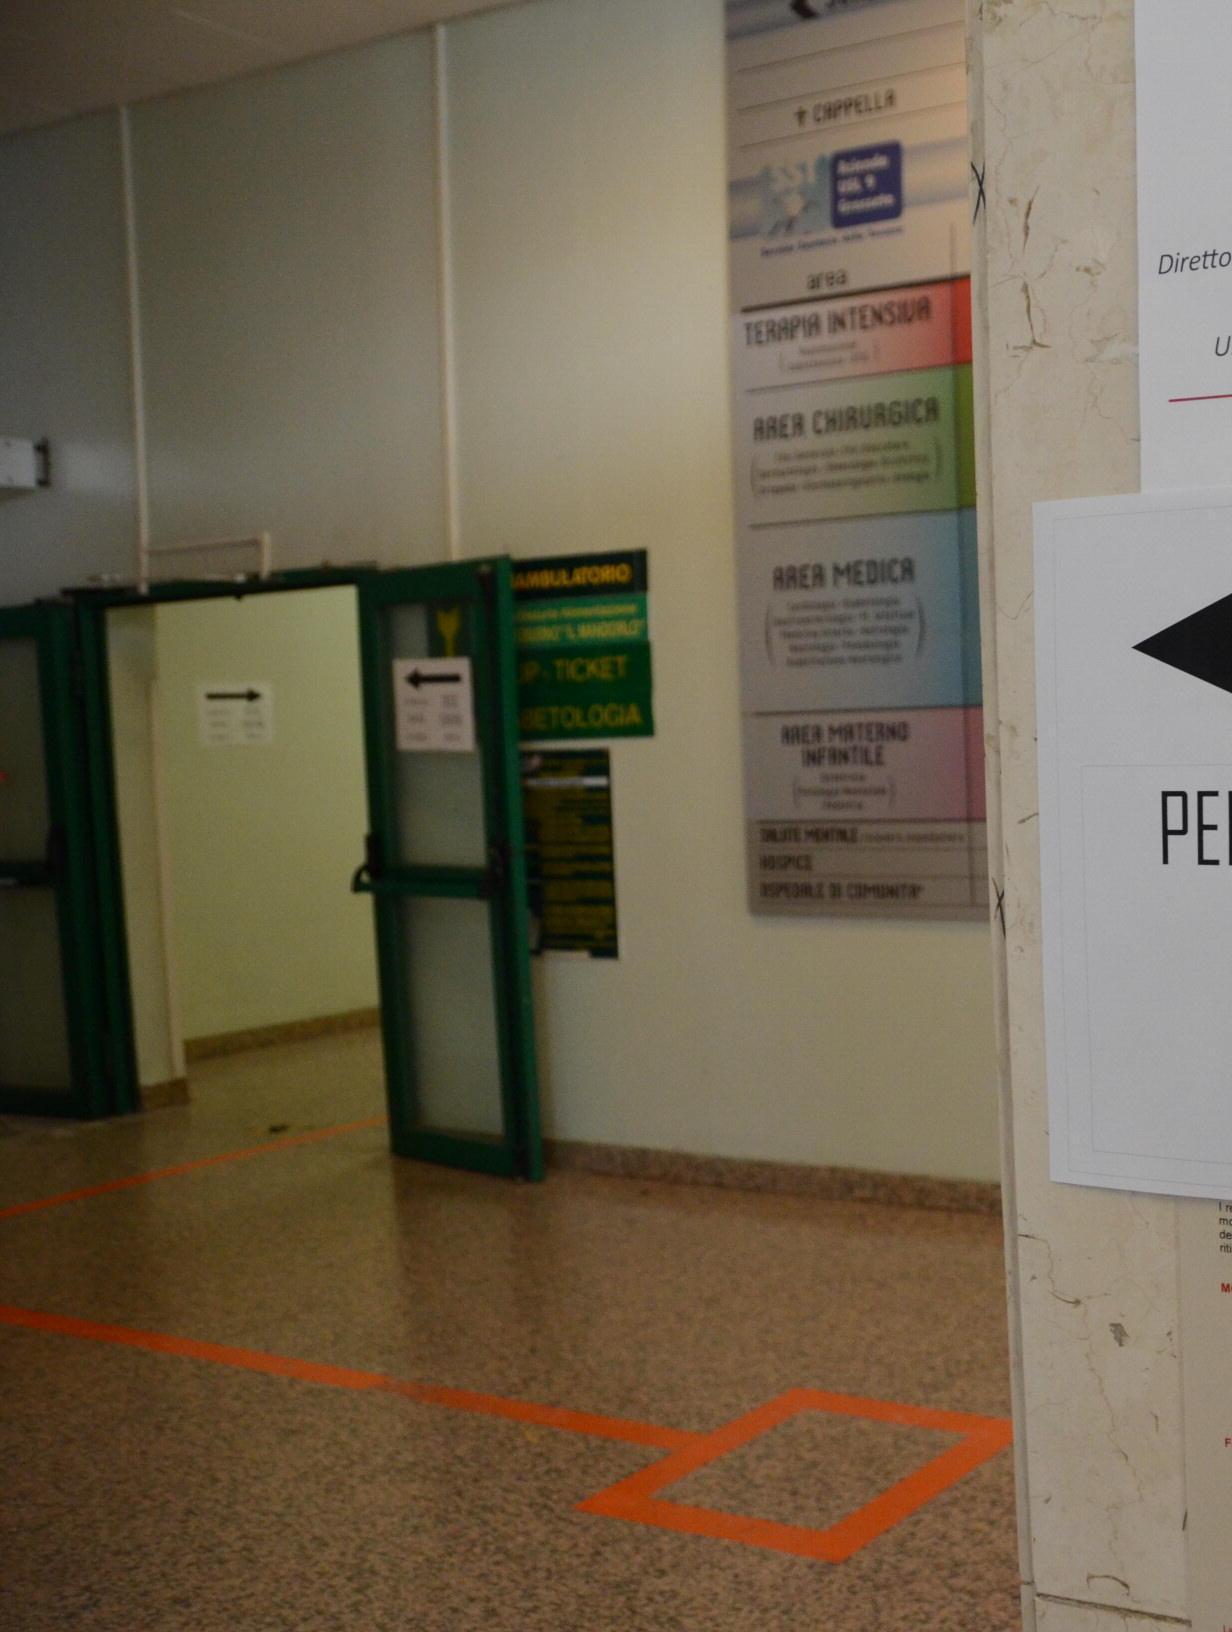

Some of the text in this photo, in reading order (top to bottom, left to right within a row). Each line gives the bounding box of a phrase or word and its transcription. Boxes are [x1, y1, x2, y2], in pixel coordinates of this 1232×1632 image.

[812, 88, 897, 123] CAPPELLA
[806, 269, 847, 290] area
[744, 296, 931, 346] TERAPIA INTENSIVA
[753, 397, 940, 440] AREA CHIRURGICA
[772, 557, 915, 591] AREA MEDICA
[555, 655, 627, 682] TICKET
[781, 721, 909, 746] AREA MATERNO
[802, 745, 885, 768] INFANTILE
